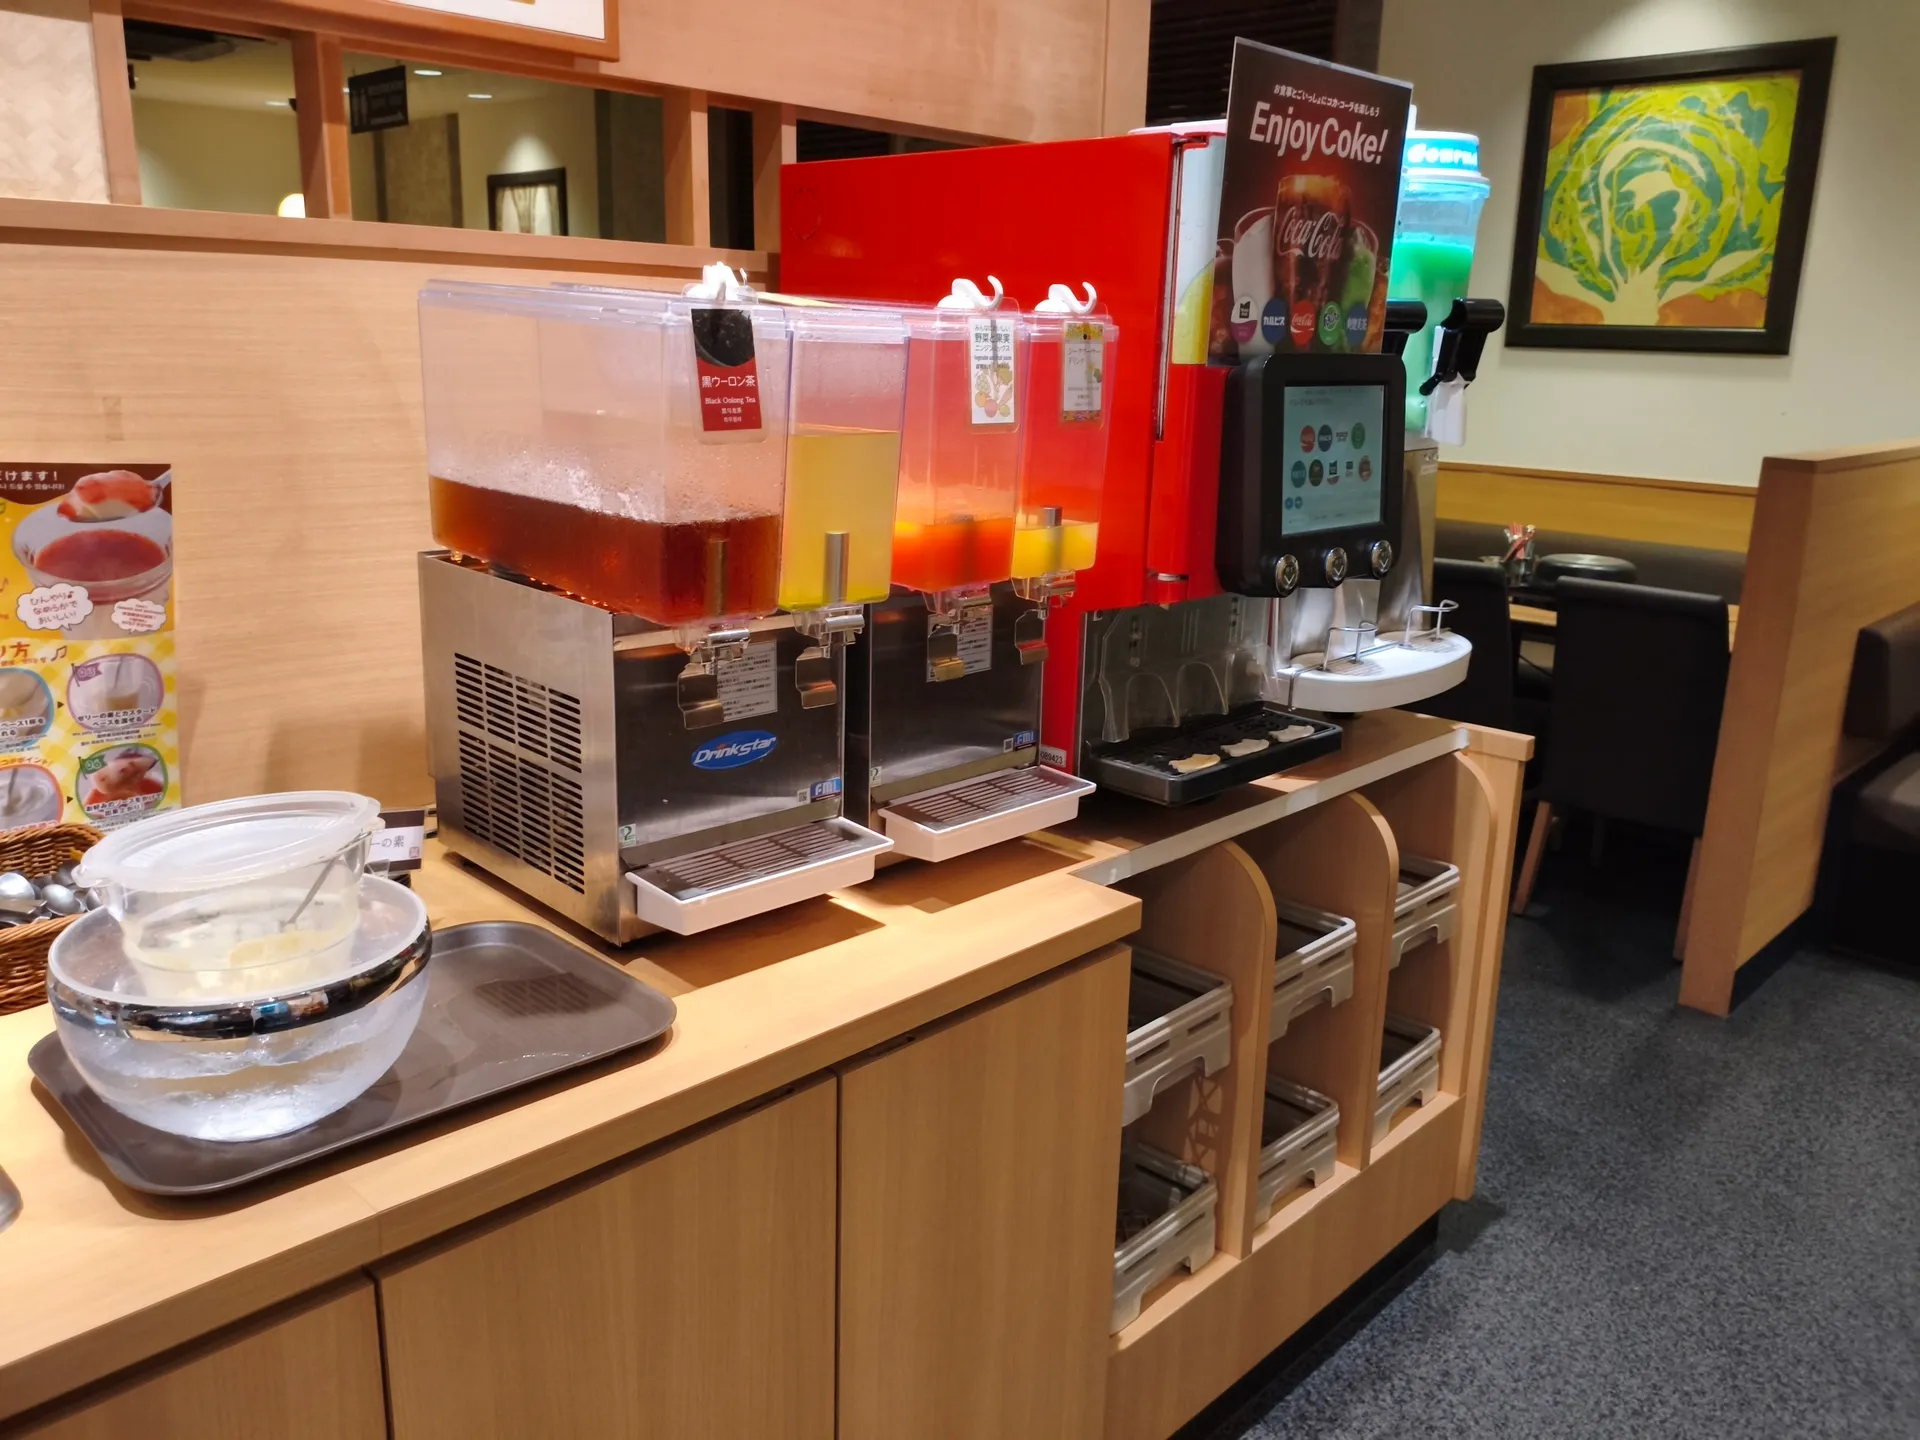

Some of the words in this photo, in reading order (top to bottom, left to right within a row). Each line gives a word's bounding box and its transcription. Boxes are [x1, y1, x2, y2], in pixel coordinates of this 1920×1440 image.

[1250, 101, 1320, 162] Enjoy
[1320, 117, 1389, 164] Coke!
[1263, 316, 1285, 326] カルピス
[702, 375, 756, 388] 黒ウーロン茶
[705, 397, 721, 405] Black
[722, 397, 744, 405] Oolong
